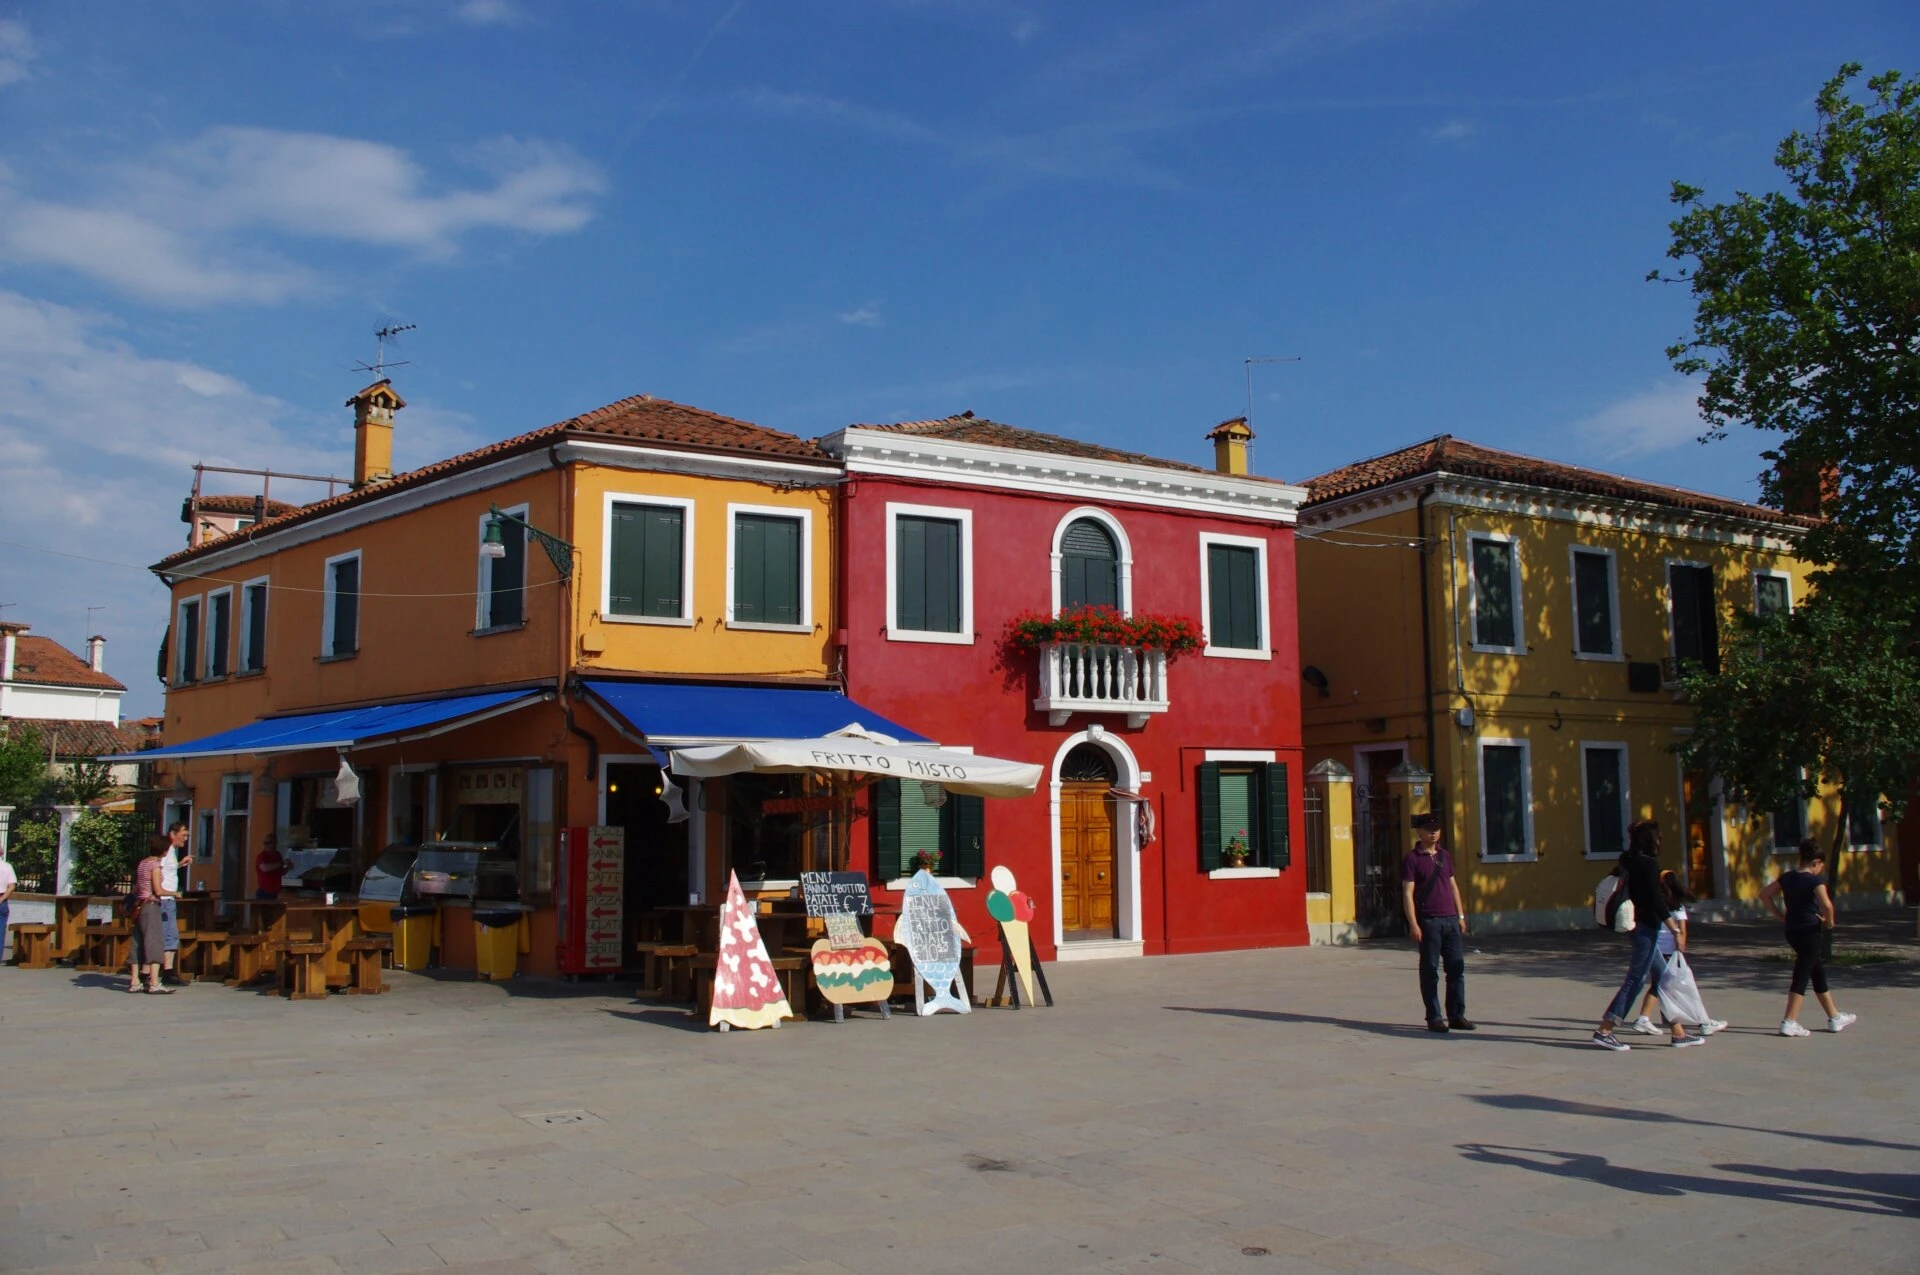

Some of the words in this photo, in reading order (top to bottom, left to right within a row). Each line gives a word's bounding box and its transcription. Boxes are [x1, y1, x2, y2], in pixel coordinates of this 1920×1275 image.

[811, 750, 891, 769] FRITTO
[907, 760, 967, 780] MISTO
[588, 849, 622, 858] PANINI
[803, 883, 829, 894] PANINO
[831, 883, 866, 894] IMBOTTITO
[585, 895, 623, 905] PIZZA
[805, 894, 840, 905] PATATE
[906, 895, 940, 907] MENU
[807, 905, 841, 917] FRITTE
[909, 907, 941, 920] PESCE
[586, 919, 622, 929] GELATI
[910, 919, 949, 932] FRITTO
[911, 931, 948, 944] PATATE
[585, 942, 620, 953] BIBITE
